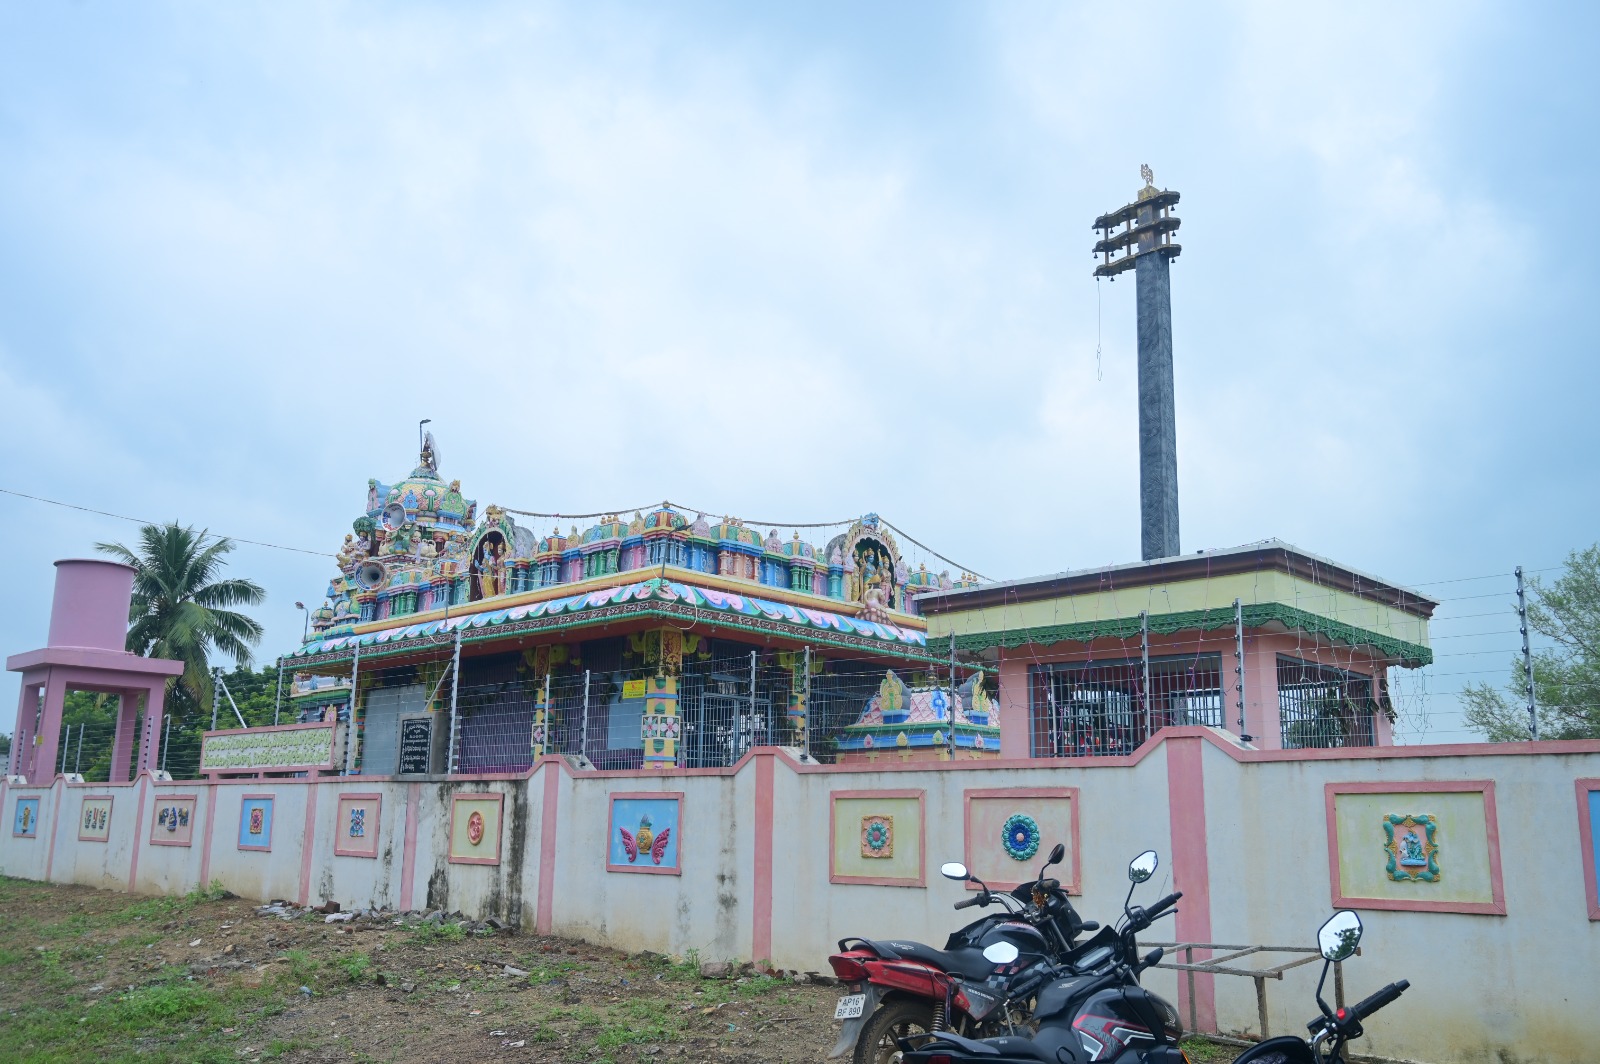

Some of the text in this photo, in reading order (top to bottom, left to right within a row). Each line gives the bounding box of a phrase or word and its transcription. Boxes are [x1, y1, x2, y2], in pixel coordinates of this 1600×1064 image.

[842, 998, 860, 1006] AP16
[837, 1007, 860, 1016] BF 890
